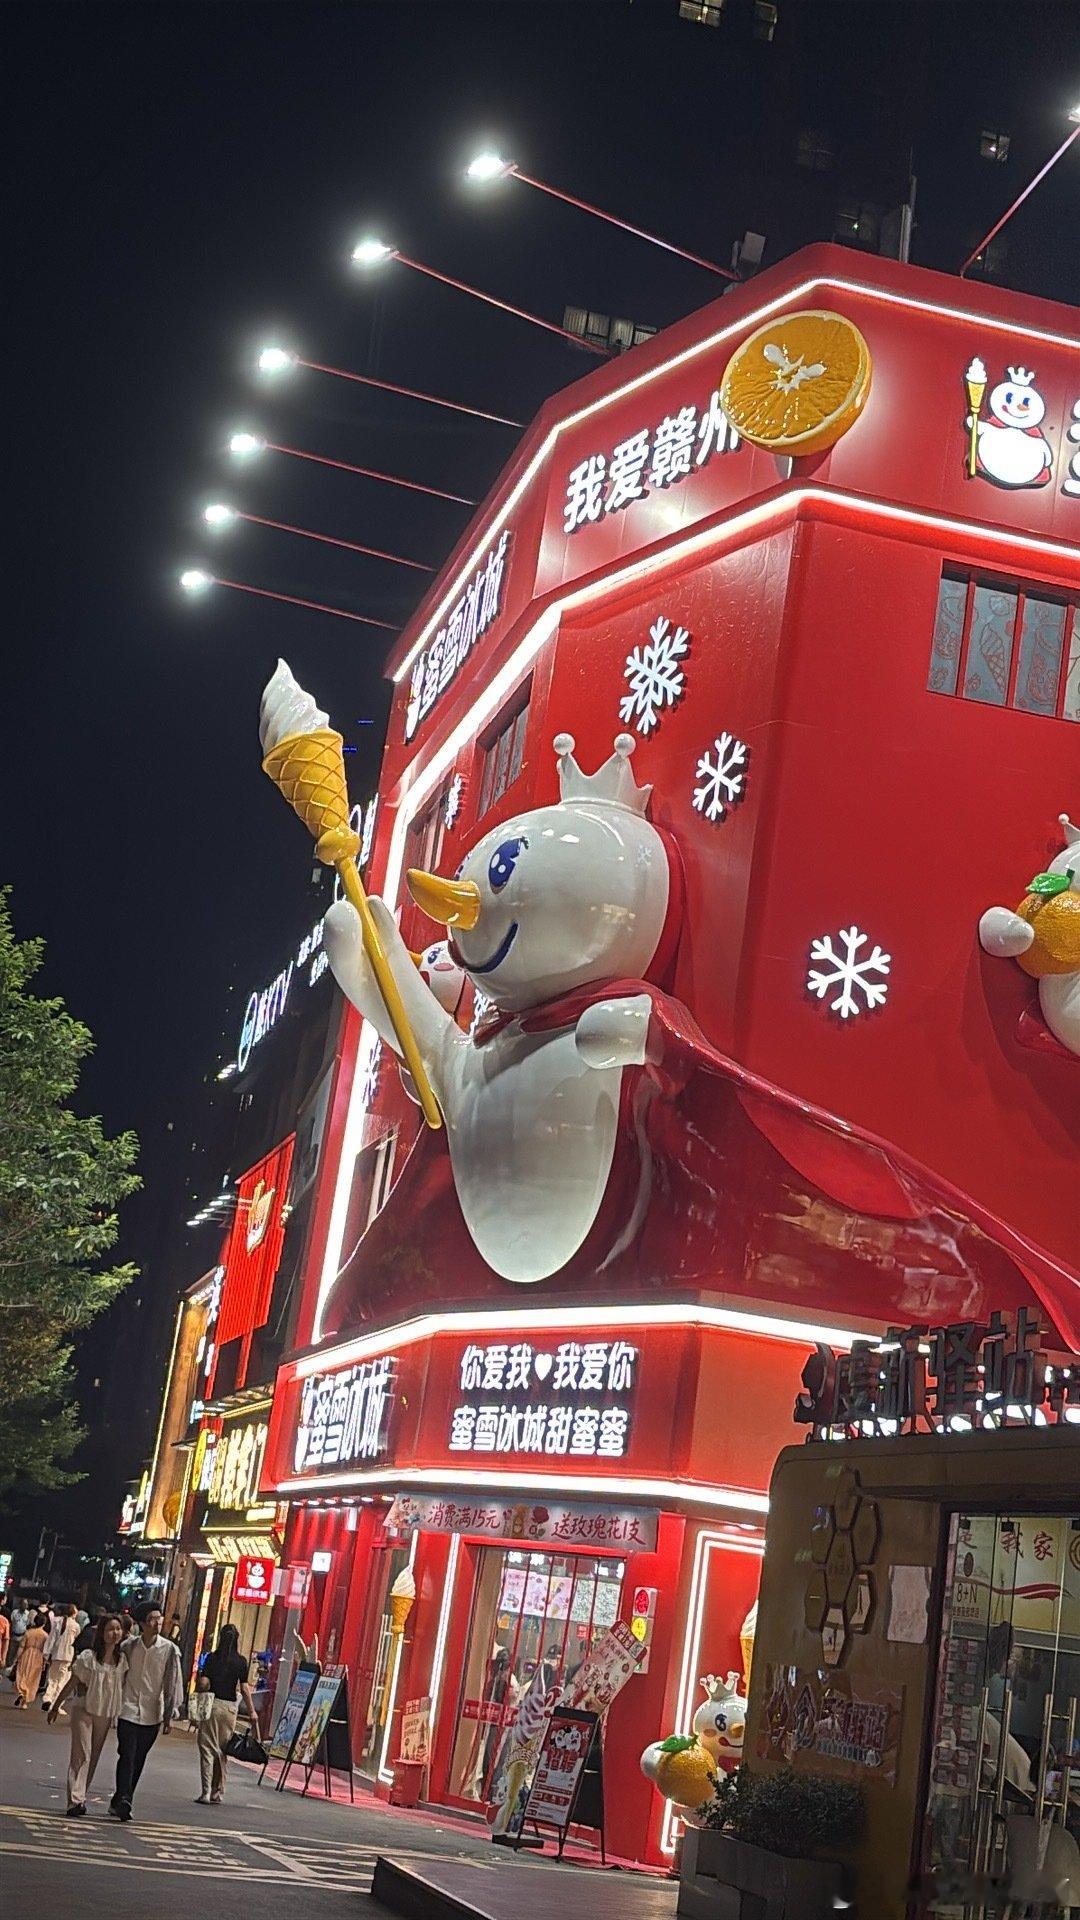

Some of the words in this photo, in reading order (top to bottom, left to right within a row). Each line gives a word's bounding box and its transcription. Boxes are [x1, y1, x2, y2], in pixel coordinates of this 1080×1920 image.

[305, 1355, 391, 1467] 蜜雪冰城
[448, 1404, 628, 1457] 蜜雪冰城甜蜜蜜
[428, 1502, 500, 1529] 消费满15元
